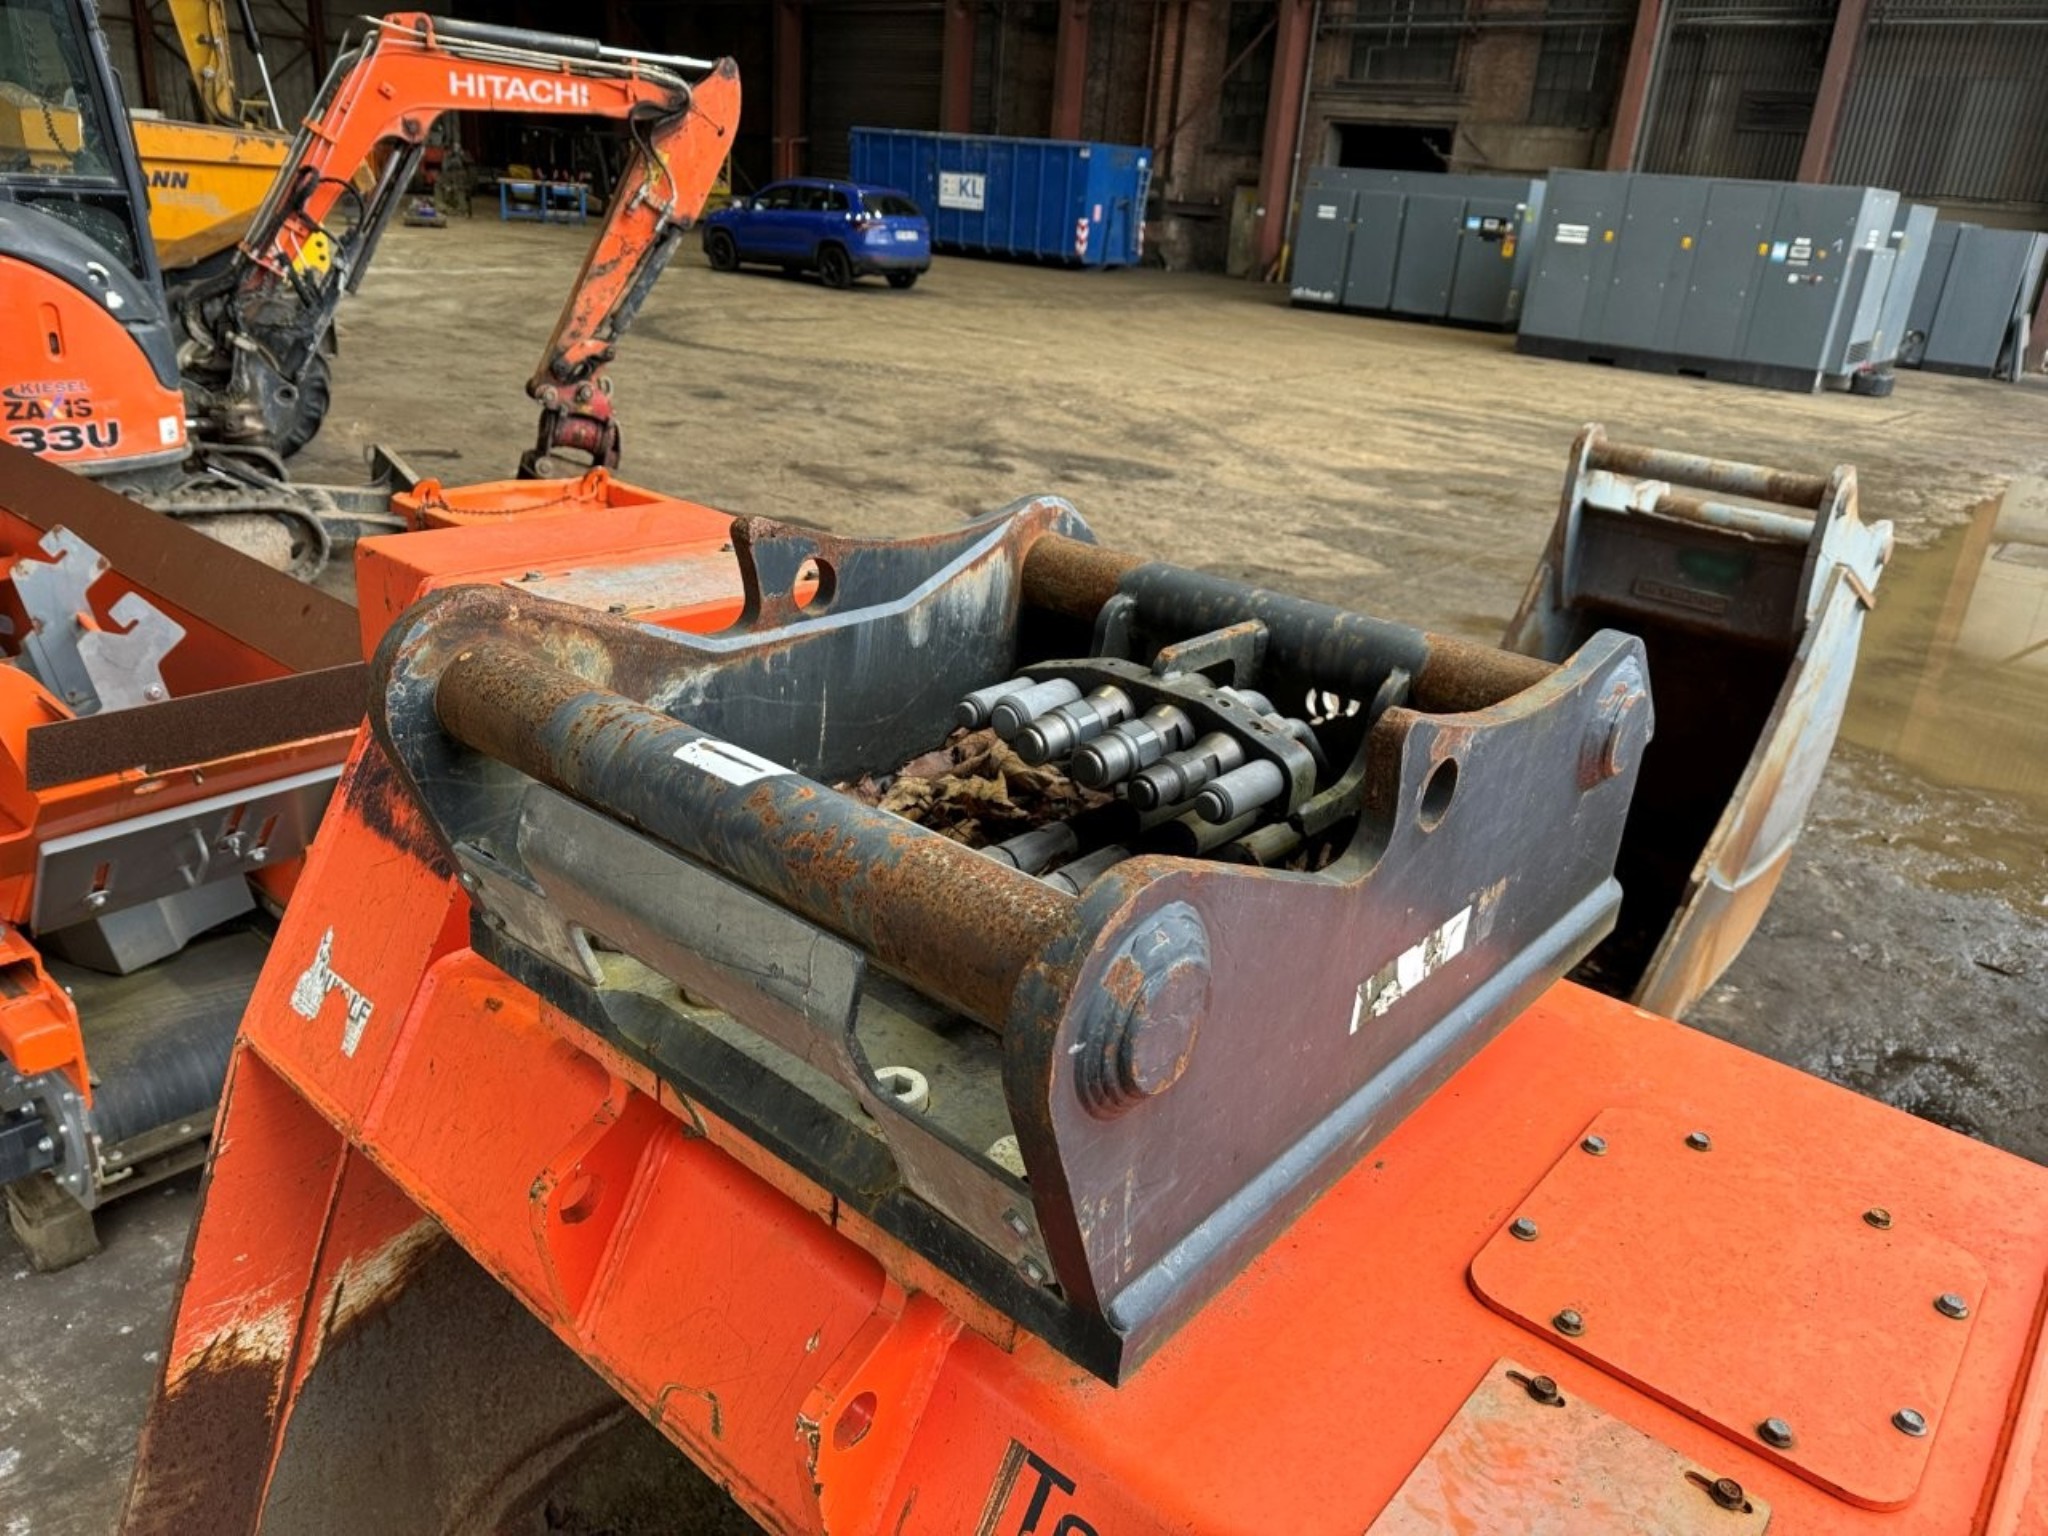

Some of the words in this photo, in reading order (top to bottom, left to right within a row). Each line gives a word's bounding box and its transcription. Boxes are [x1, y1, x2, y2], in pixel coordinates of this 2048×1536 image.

[448, 71, 590, 107] HITACHI
[959, 177, 981, 199] KL
[19, 381, 89, 394] KIESEL
[4, 394, 93, 421] ZAXIS
[9, 421, 119, 451] 33U
